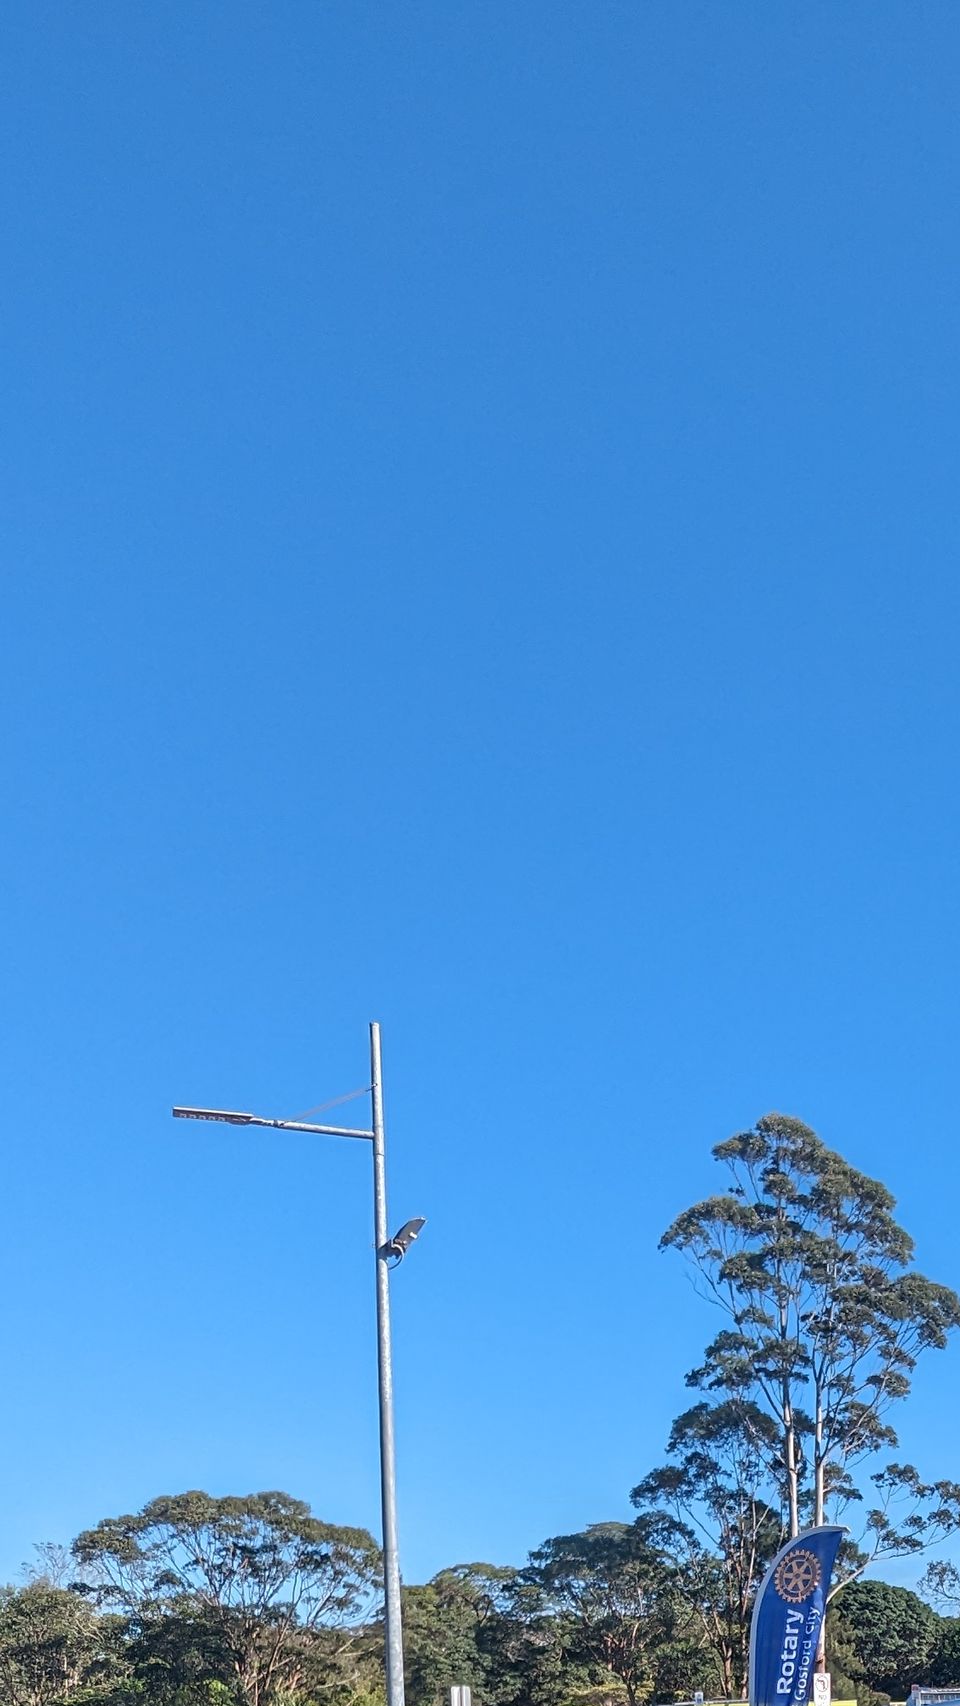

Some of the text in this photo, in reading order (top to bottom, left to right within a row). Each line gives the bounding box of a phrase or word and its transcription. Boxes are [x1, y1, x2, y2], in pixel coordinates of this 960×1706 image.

[777, 1608, 804, 1695] Rotary
[794, 1640, 811, 1701] Gosford
[805, 1607, 820, 1635] City
